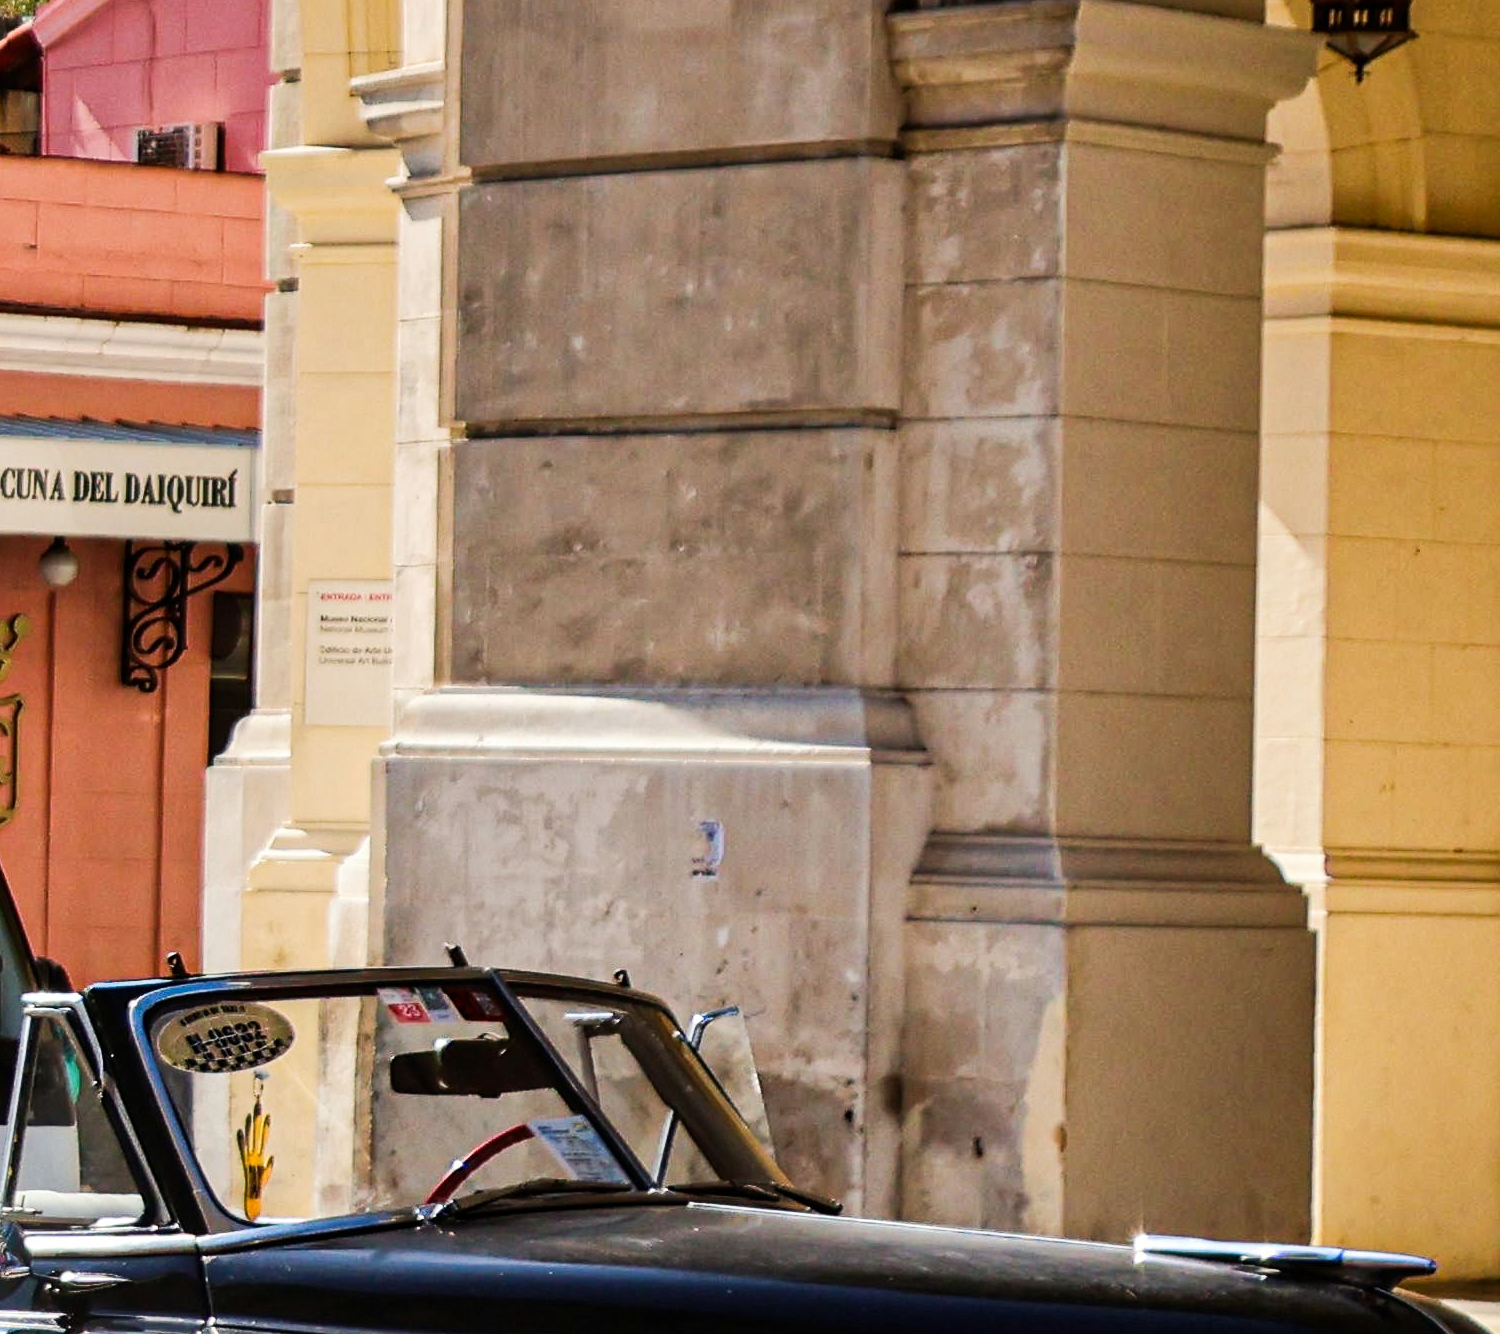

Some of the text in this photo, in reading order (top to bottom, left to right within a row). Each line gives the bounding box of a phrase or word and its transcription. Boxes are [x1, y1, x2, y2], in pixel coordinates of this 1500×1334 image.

[0, 468, 66, 502] CUNA
[73, 470, 119, 504] DEL
[123, 468, 238, 514] DAIQUIRÍ
